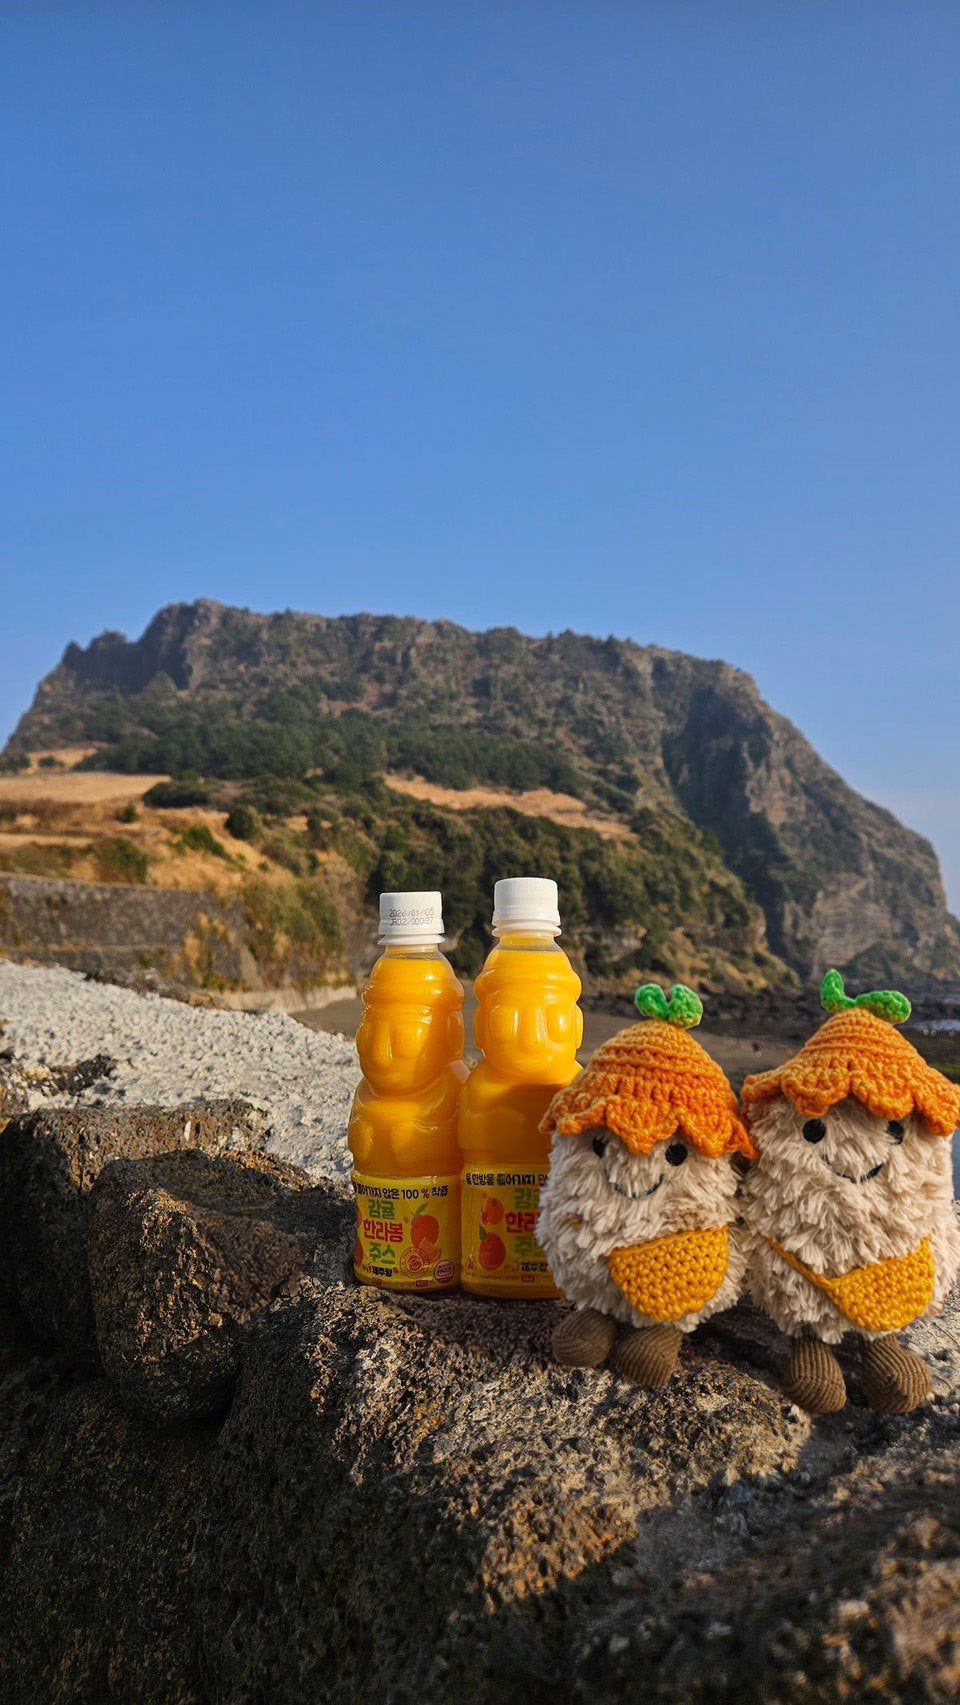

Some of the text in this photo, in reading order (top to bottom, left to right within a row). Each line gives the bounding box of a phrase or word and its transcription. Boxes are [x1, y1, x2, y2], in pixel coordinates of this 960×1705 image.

[497, 1173, 535, 1186] 들어가지
[383, 1187, 399, 1200] 않은
[402, 1189, 419, 1200] 100
[432, 1185, 448, 1197] 착즙
[367, 1199, 396, 1220] 감귤
[363, 1219, 404, 1243] 한라봉
[505, 1211, 540, 1233] 한라
[369, 1242, 396, 1265] 주스
